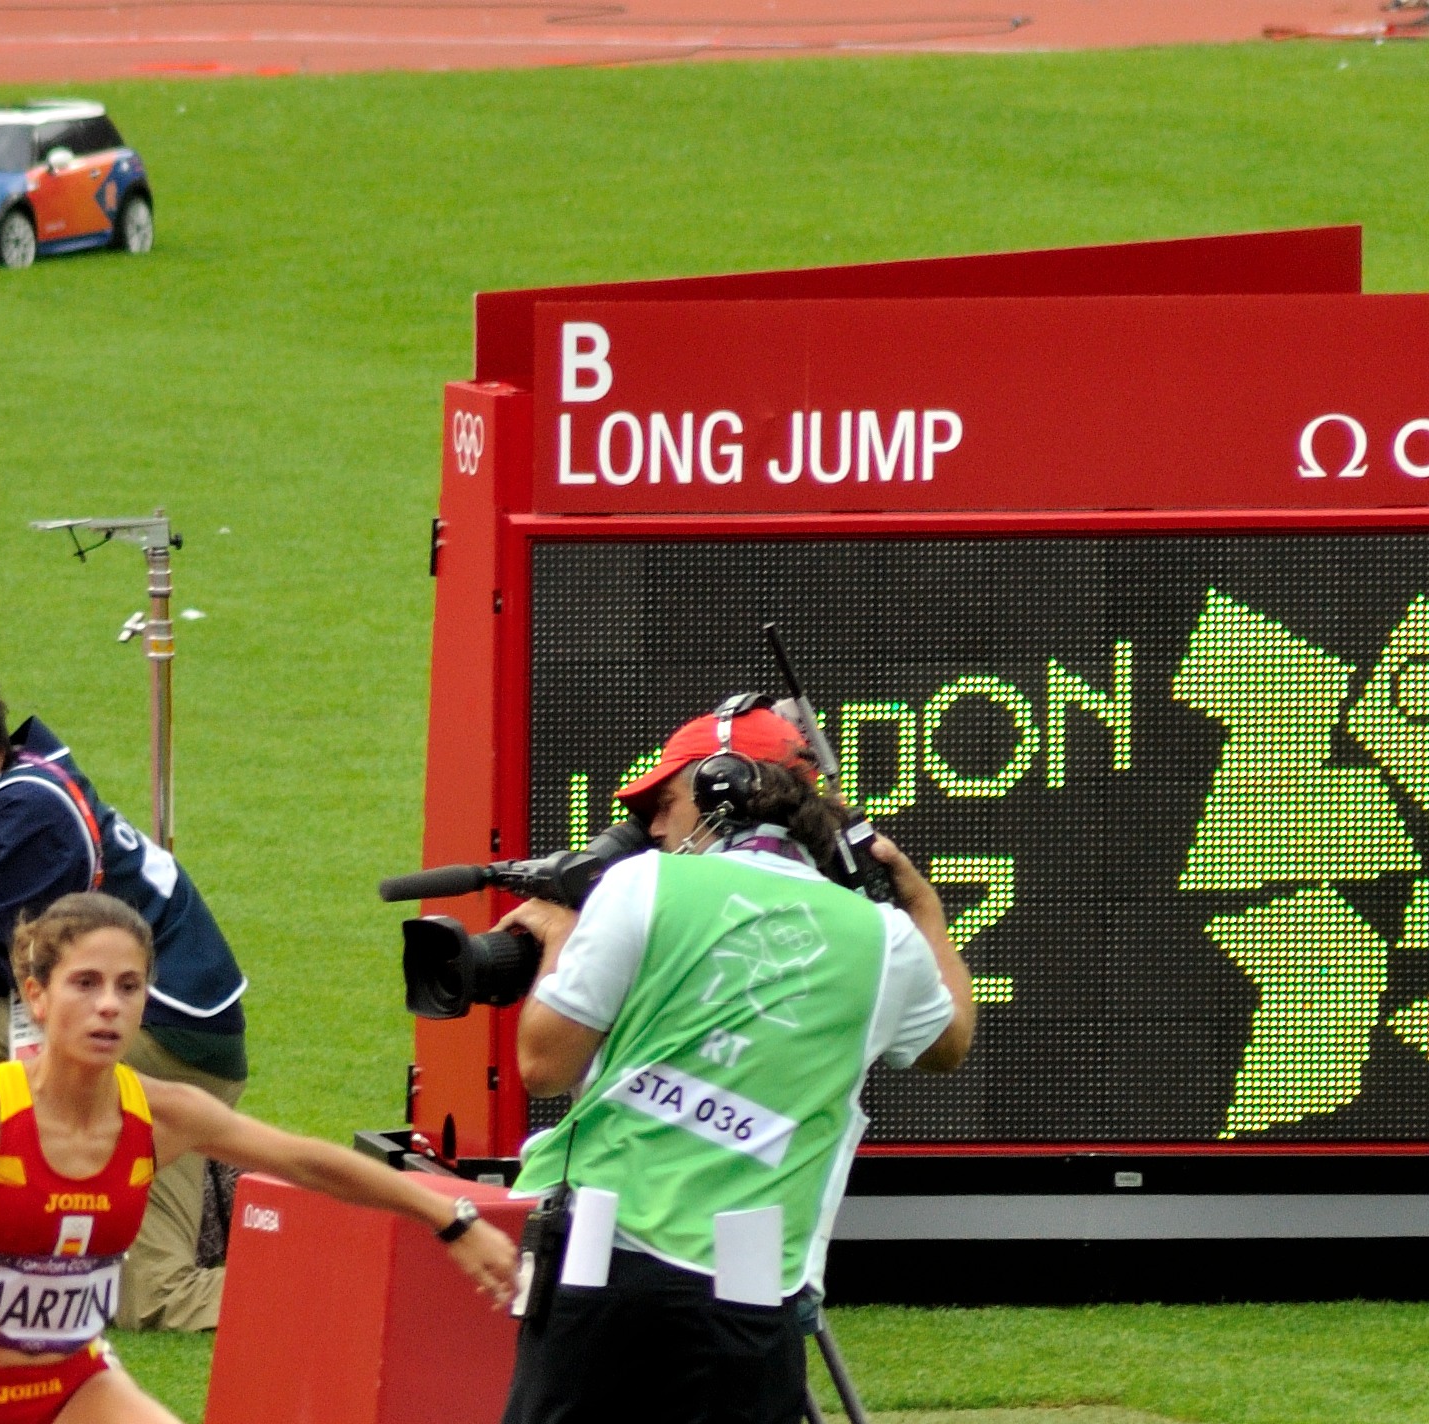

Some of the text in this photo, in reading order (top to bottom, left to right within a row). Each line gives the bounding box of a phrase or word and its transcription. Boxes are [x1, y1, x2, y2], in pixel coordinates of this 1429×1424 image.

[560, 321, 614, 403] B
[558, 409, 964, 486] LONG JUMP
[628, 1071, 755, 1142] STA 036
